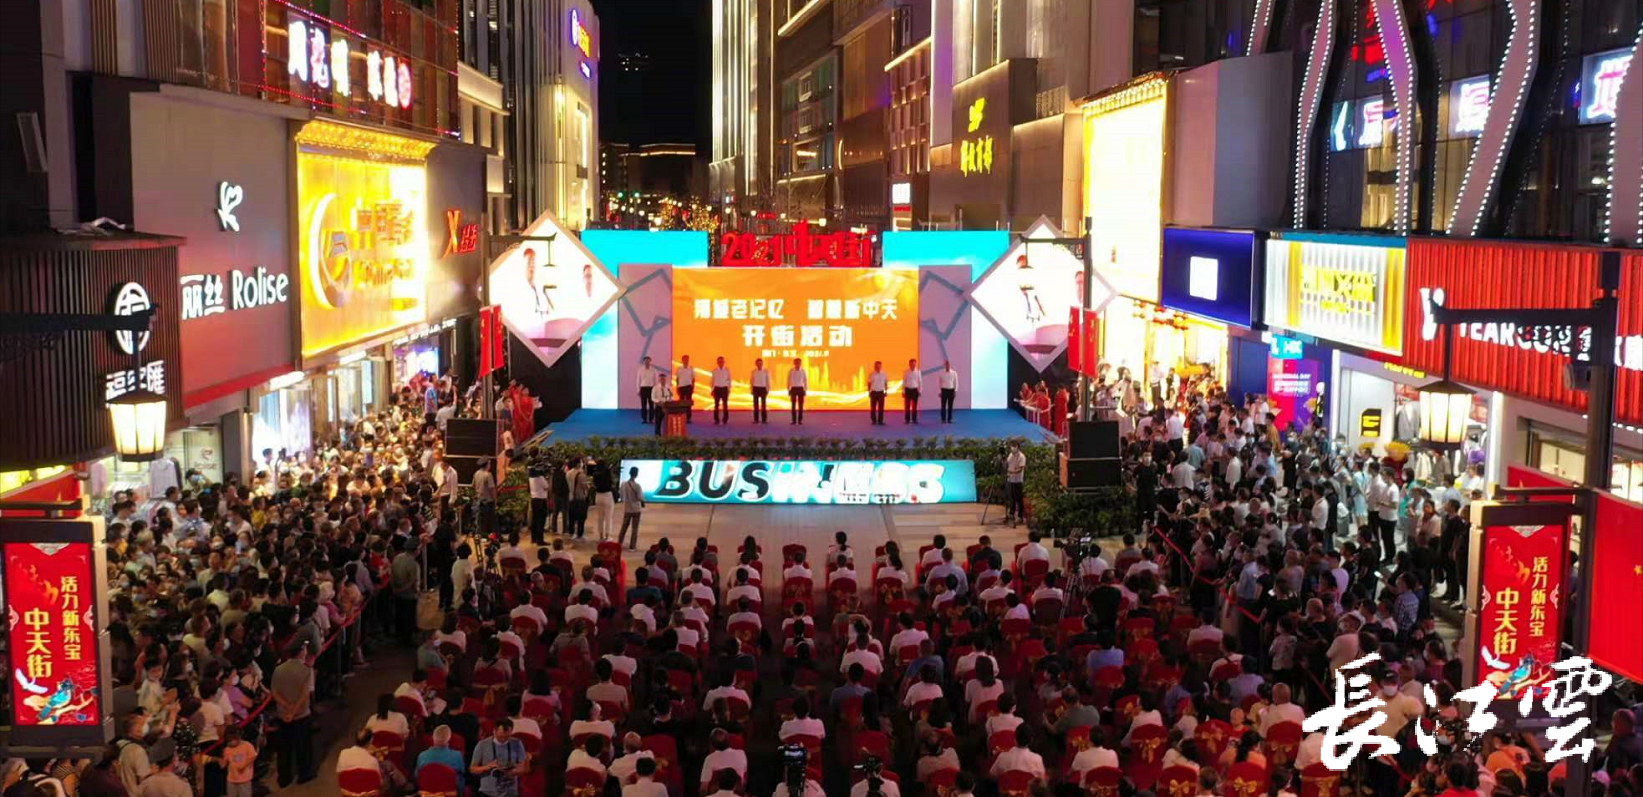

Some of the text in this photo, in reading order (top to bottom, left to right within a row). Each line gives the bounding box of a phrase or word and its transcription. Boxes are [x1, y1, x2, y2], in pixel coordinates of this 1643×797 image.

[180, 266, 289, 320] 丽丝 Rolise
[742, 325, 853, 347] 开街活动
[60, 576, 82, 661] 活力新东宝
[1493, 587, 1520, 656] 中天街
[1529, 557, 1549, 637] 活力新东宝
[24, 607, 53, 679] 中天街
